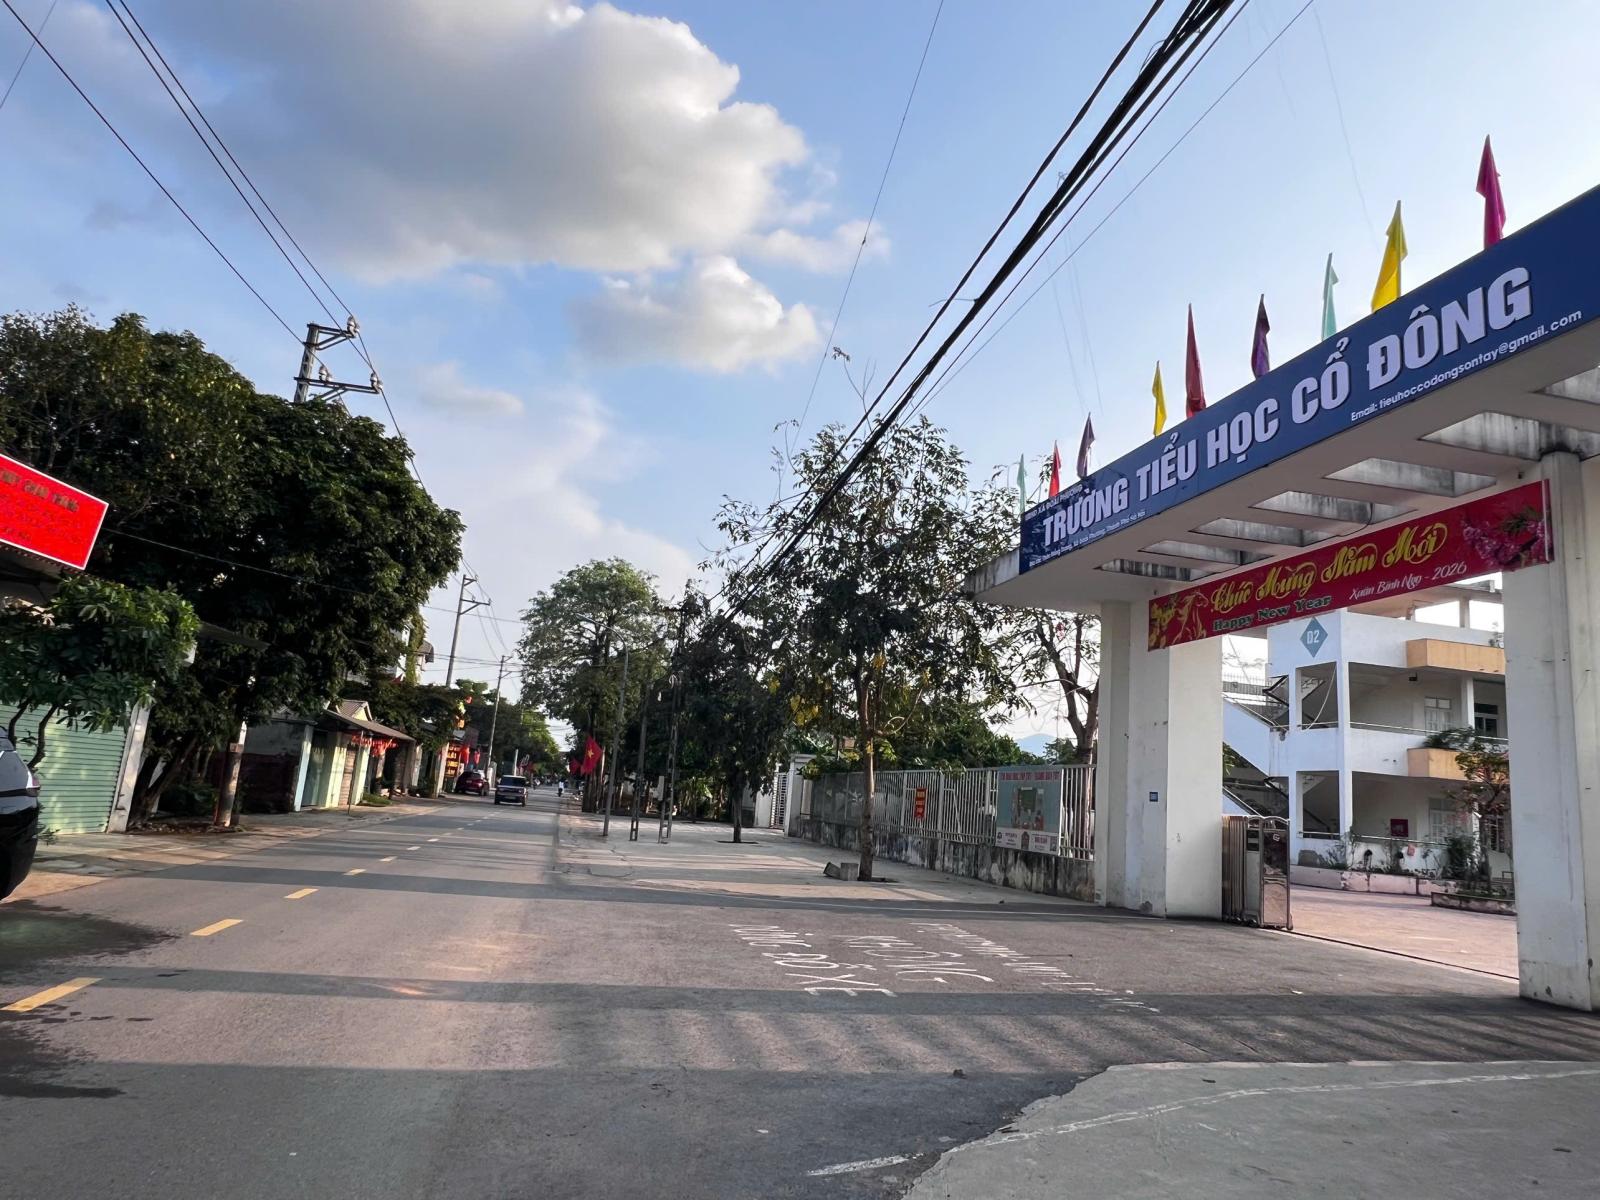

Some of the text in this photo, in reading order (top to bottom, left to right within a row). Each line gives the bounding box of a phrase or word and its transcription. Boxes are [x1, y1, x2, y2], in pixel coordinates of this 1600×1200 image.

[1042, 267, 1532, 547] TRƯỜNG TIỂU HỌC CỔ ĐÔNG
[1351, 403, 1379, 421] Email:
[1211, 522, 1448, 613] Chúc Mừng Năm Mới
[1431, 561, 1468, 581] 2026
[1213, 596, 1332, 632] Happy New Year
[830, 934, 994, 984] KHÔNG
[784, 972, 898, 998] XE
